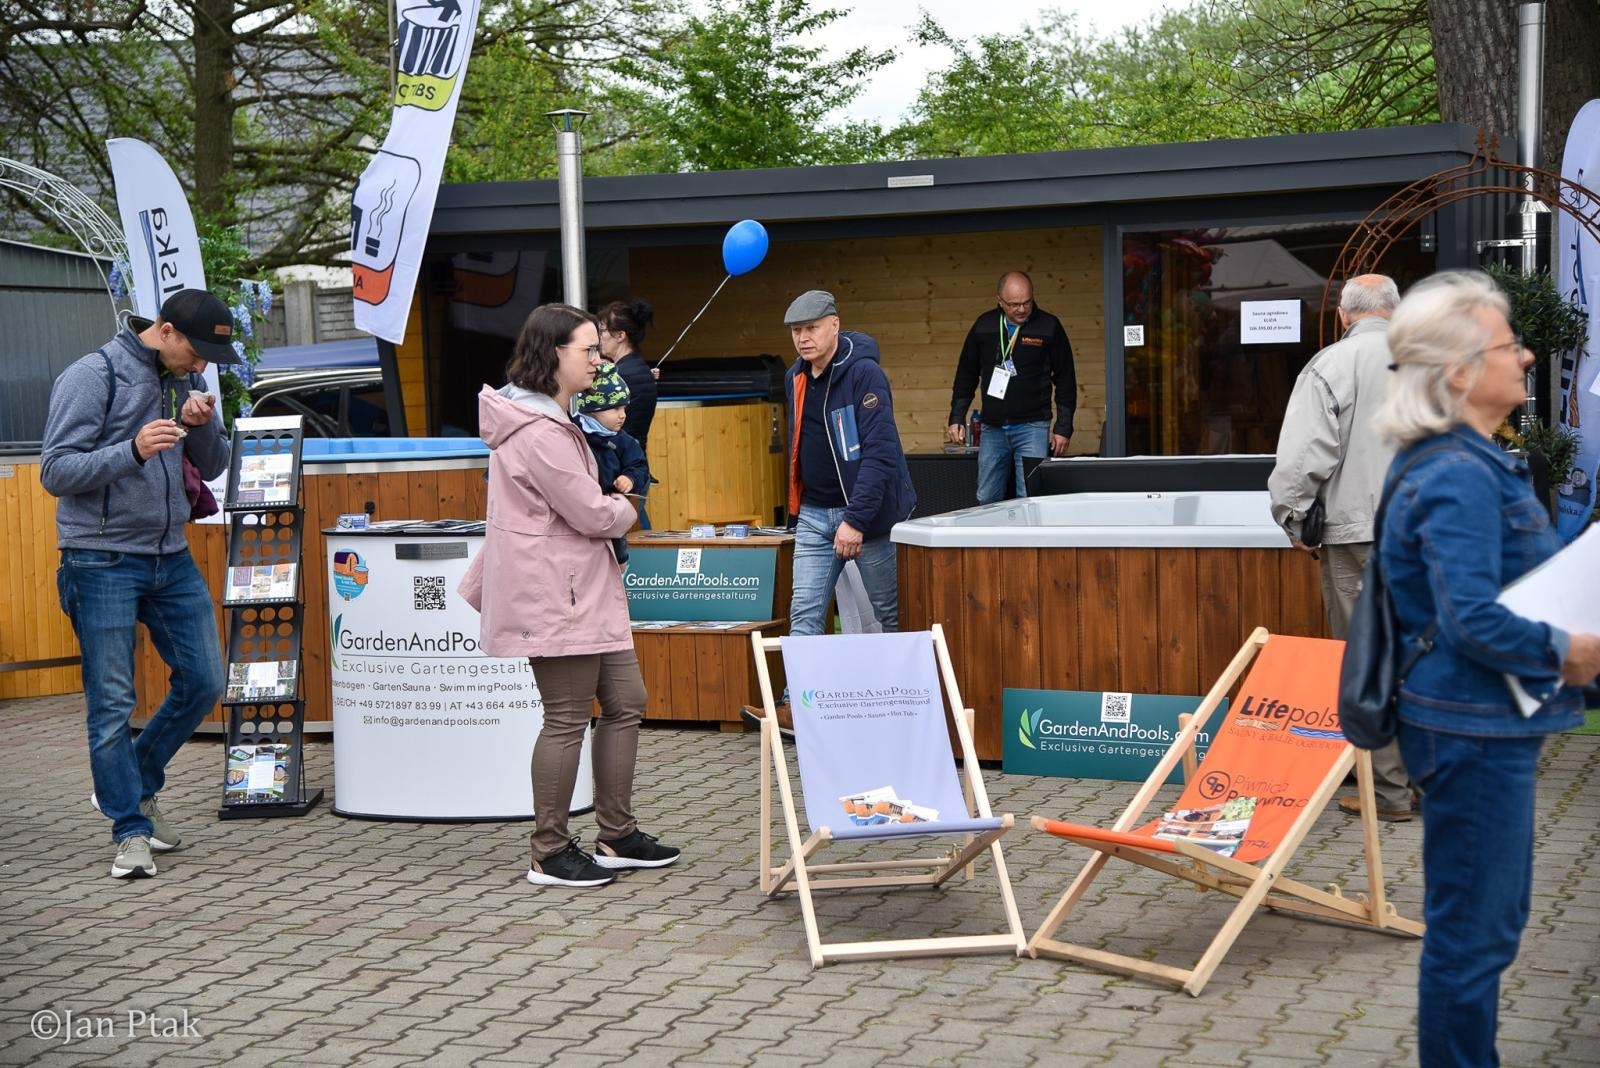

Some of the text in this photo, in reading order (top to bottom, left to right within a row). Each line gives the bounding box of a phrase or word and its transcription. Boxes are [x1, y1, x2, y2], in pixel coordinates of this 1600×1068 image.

[625, 572, 760, 586] GardenAndPools.com
[627, 591, 757, 601] Exclusive Gartengestaltung
[340, 629, 481, 652] GardenAndPo
[342, 660, 405, 674] Exclusive
[372, 681, 431, 692] GartenSauna
[358, 699, 373, 708] +49
[449, 701, 463, 711] AT
[465, 701, 484, 710] +43
[486, 700, 505, 710] 664
[508, 700, 528, 709] 495
[1240, 696, 1340, 731] Lifepols
[373, 716, 500, 727] info@gardenandpools.com
[1039, 719, 1209, 743] GardenAndPools.cm
[1041, 741, 1095, 753] Exclusive
